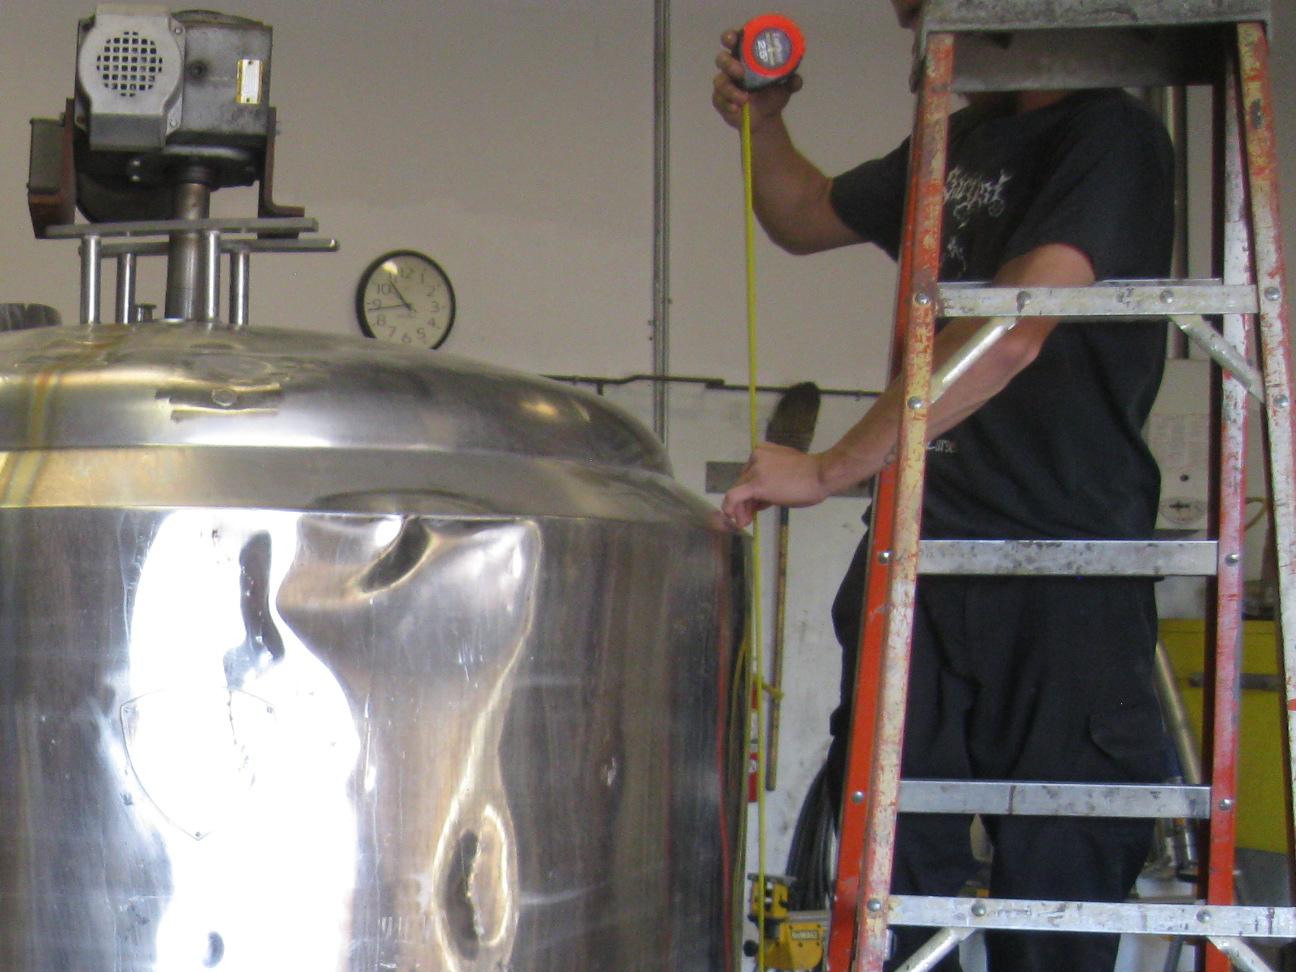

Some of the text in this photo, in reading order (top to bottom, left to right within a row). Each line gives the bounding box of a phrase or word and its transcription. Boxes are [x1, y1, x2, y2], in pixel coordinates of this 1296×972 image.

[400, 266, 415, 280] 12
[376, 283, 392, 296] 10
[426, 285, 436, 297] 2
[372, 298, 382, 311] 9
[430, 300, 440, 313] 3
[376, 314, 387, 327] 8
[427, 317, 436, 328] 4
[388, 325, 397, 338] 7
[401, 331, 412, 344] 6
[416, 327, 426, 340] 5
